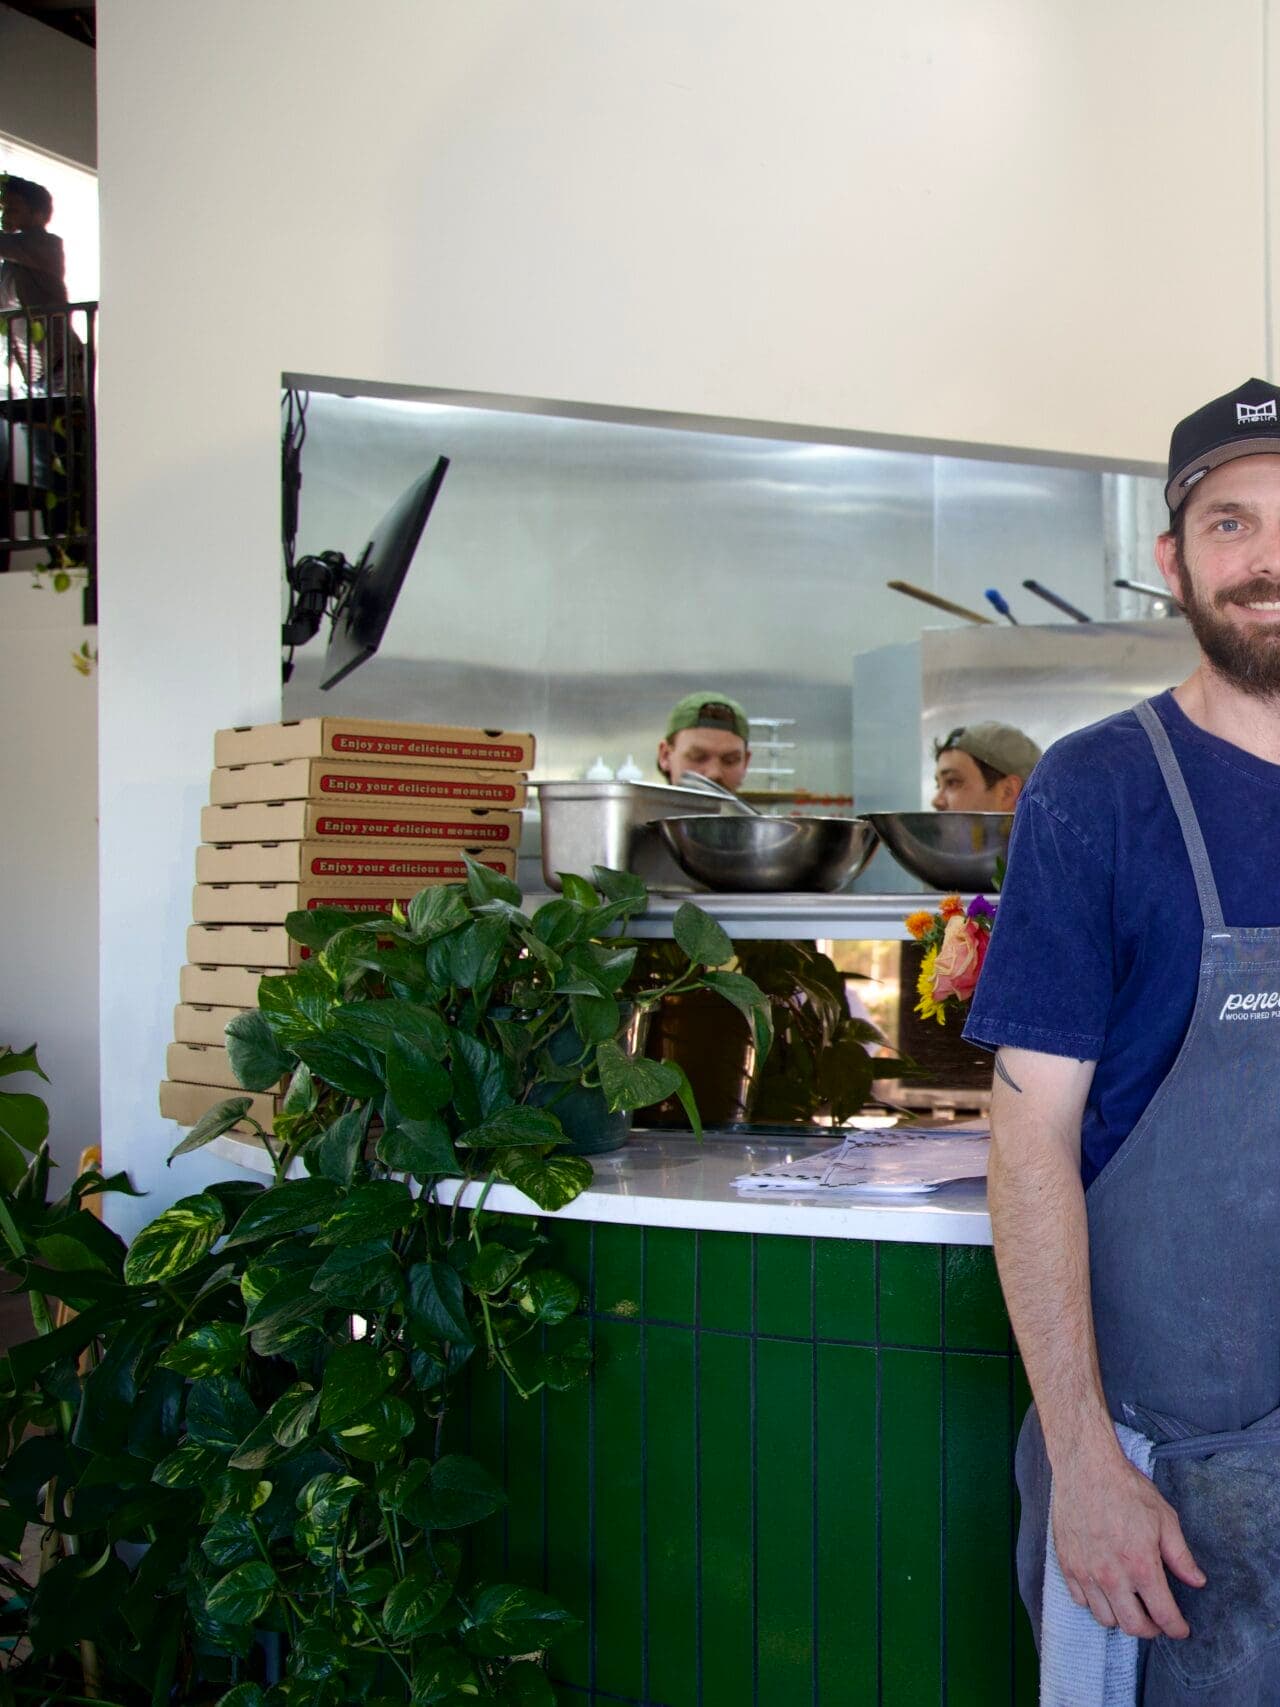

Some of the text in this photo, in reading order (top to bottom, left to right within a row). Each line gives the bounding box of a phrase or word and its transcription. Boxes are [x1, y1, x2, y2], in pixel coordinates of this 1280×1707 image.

[340, 738, 374, 751] Enjoy
[377, 742, 404, 752] your
[408, 743, 458, 755] delicious
[329, 779, 362, 792] Enjoy
[367, 783, 395, 793] your
[398, 784, 449, 795] delicious
[324, 821, 357, 833] Enjoy
[362, 824, 390, 834] your
[392, 824, 444, 835] delicious
[320, 861, 353, 873] Enjoy
[357, 864, 385, 874] your
[388, 863, 440, 874] delicious
[1250, 1011, 1270, 1020] FIRED
